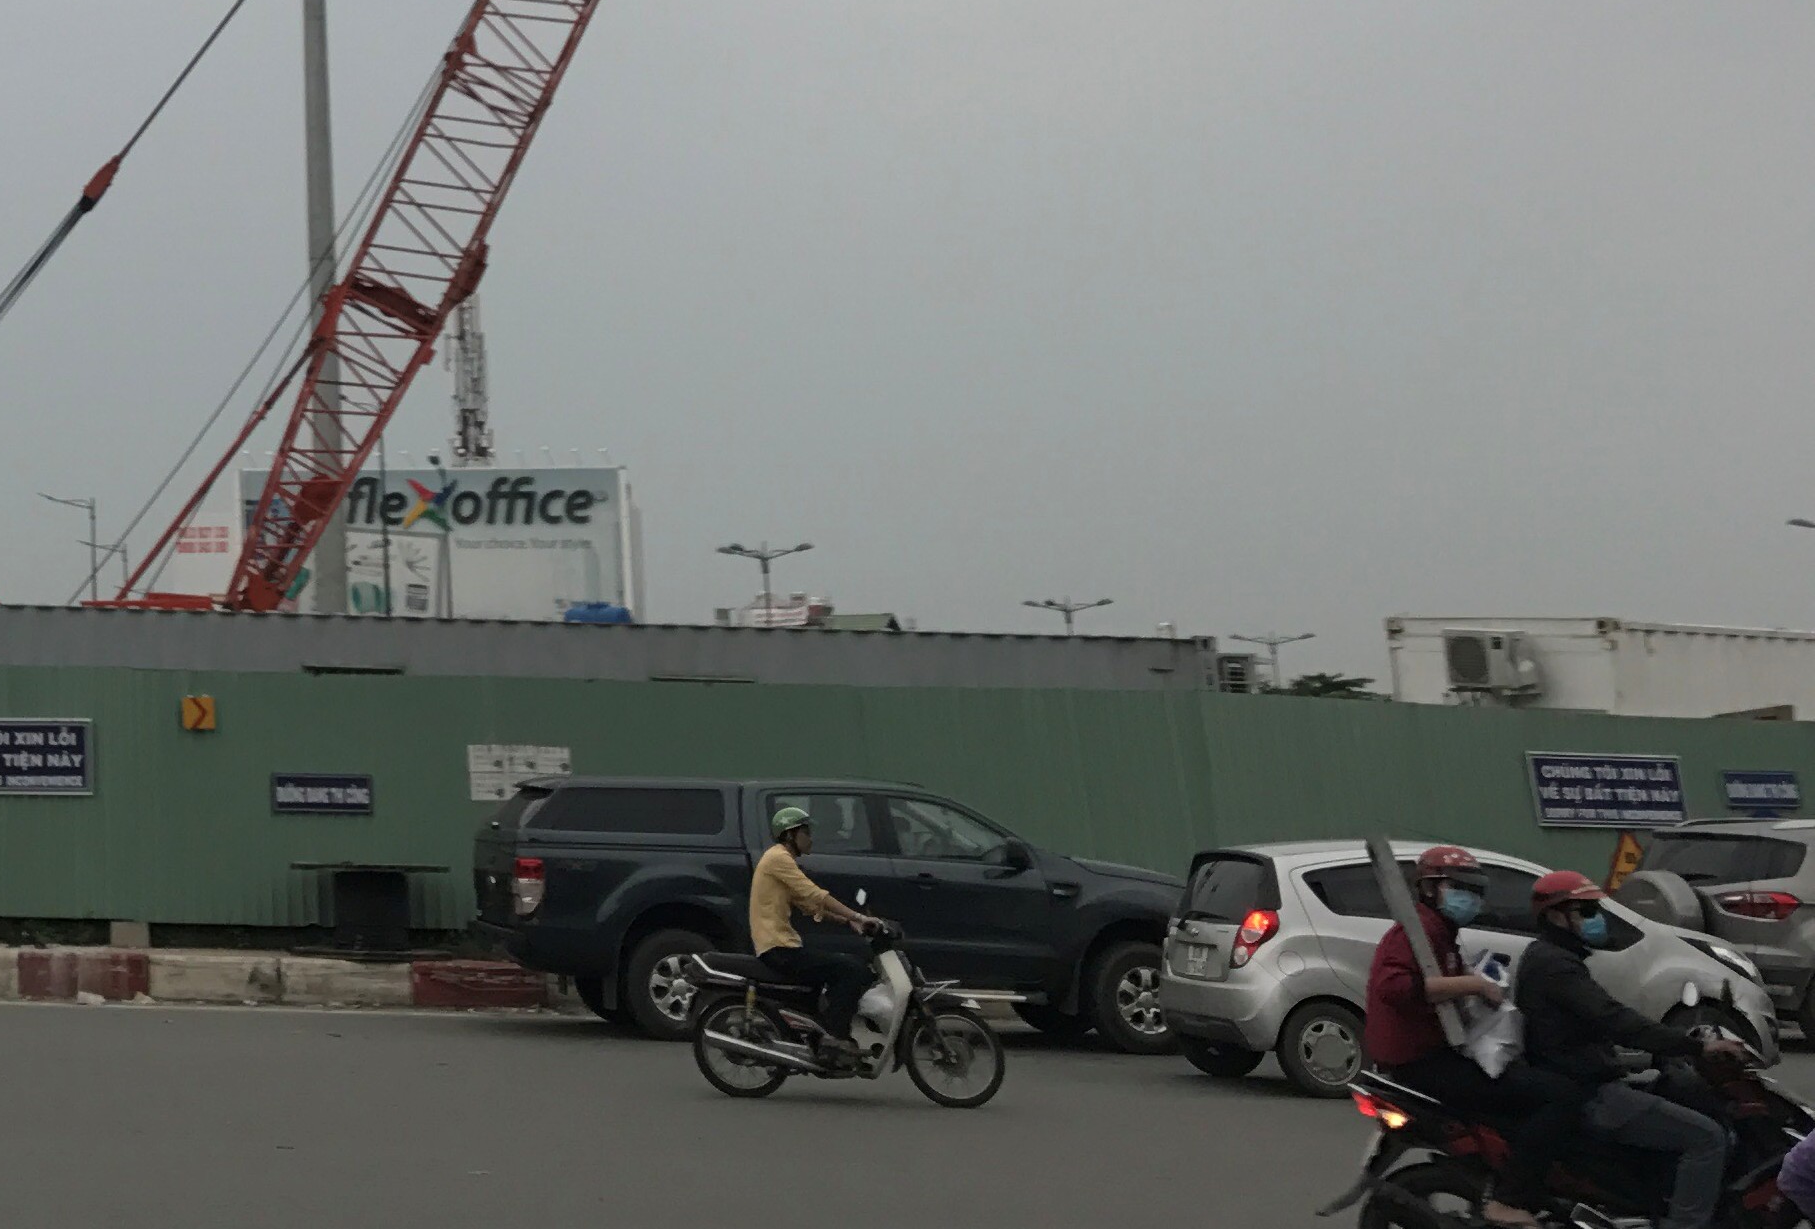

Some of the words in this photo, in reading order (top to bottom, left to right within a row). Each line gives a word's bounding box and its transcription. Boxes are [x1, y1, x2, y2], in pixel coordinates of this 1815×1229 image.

[13, 731, 44, 746] XIN
[47, 726, 77, 746] LỖI
[2, 751, 43, 771] TIỆN
[46, 750, 84, 768] NÀY
